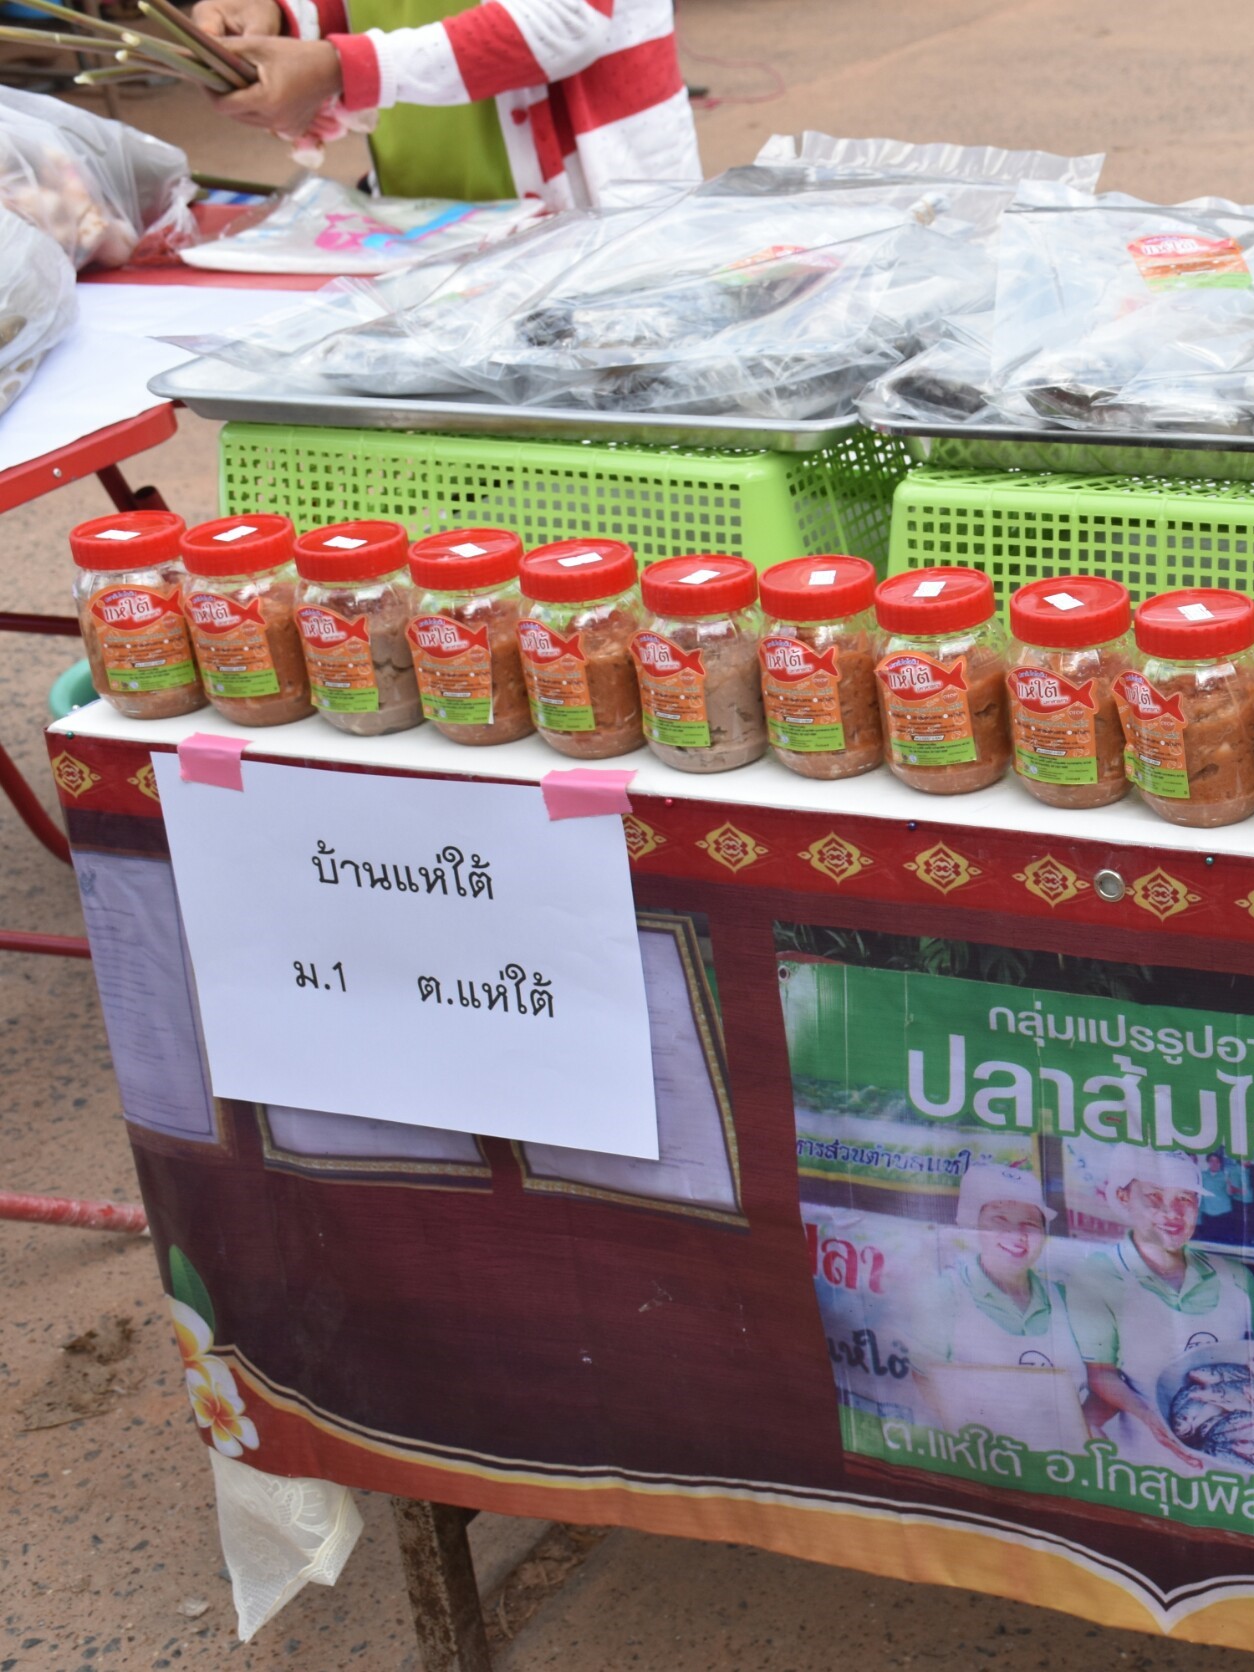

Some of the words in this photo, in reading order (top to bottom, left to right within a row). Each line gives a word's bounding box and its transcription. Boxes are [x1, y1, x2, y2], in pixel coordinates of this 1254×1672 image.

[104, 596, 150, 623] แห่ใต้
[418, 624, 456, 647] แห่ใต้
[889, 666, 930, 689] แห่ใต้
[1017, 679, 1058, 700] แห่ใต้
[311, 839, 494, 900] บ้านแห่ใต้
[292, 959, 348, 993] ม.1
[417, 963, 555, 1018] ต.แห่ใต้
[883, 1422, 1023, 1479] ต.แห่ใต้
